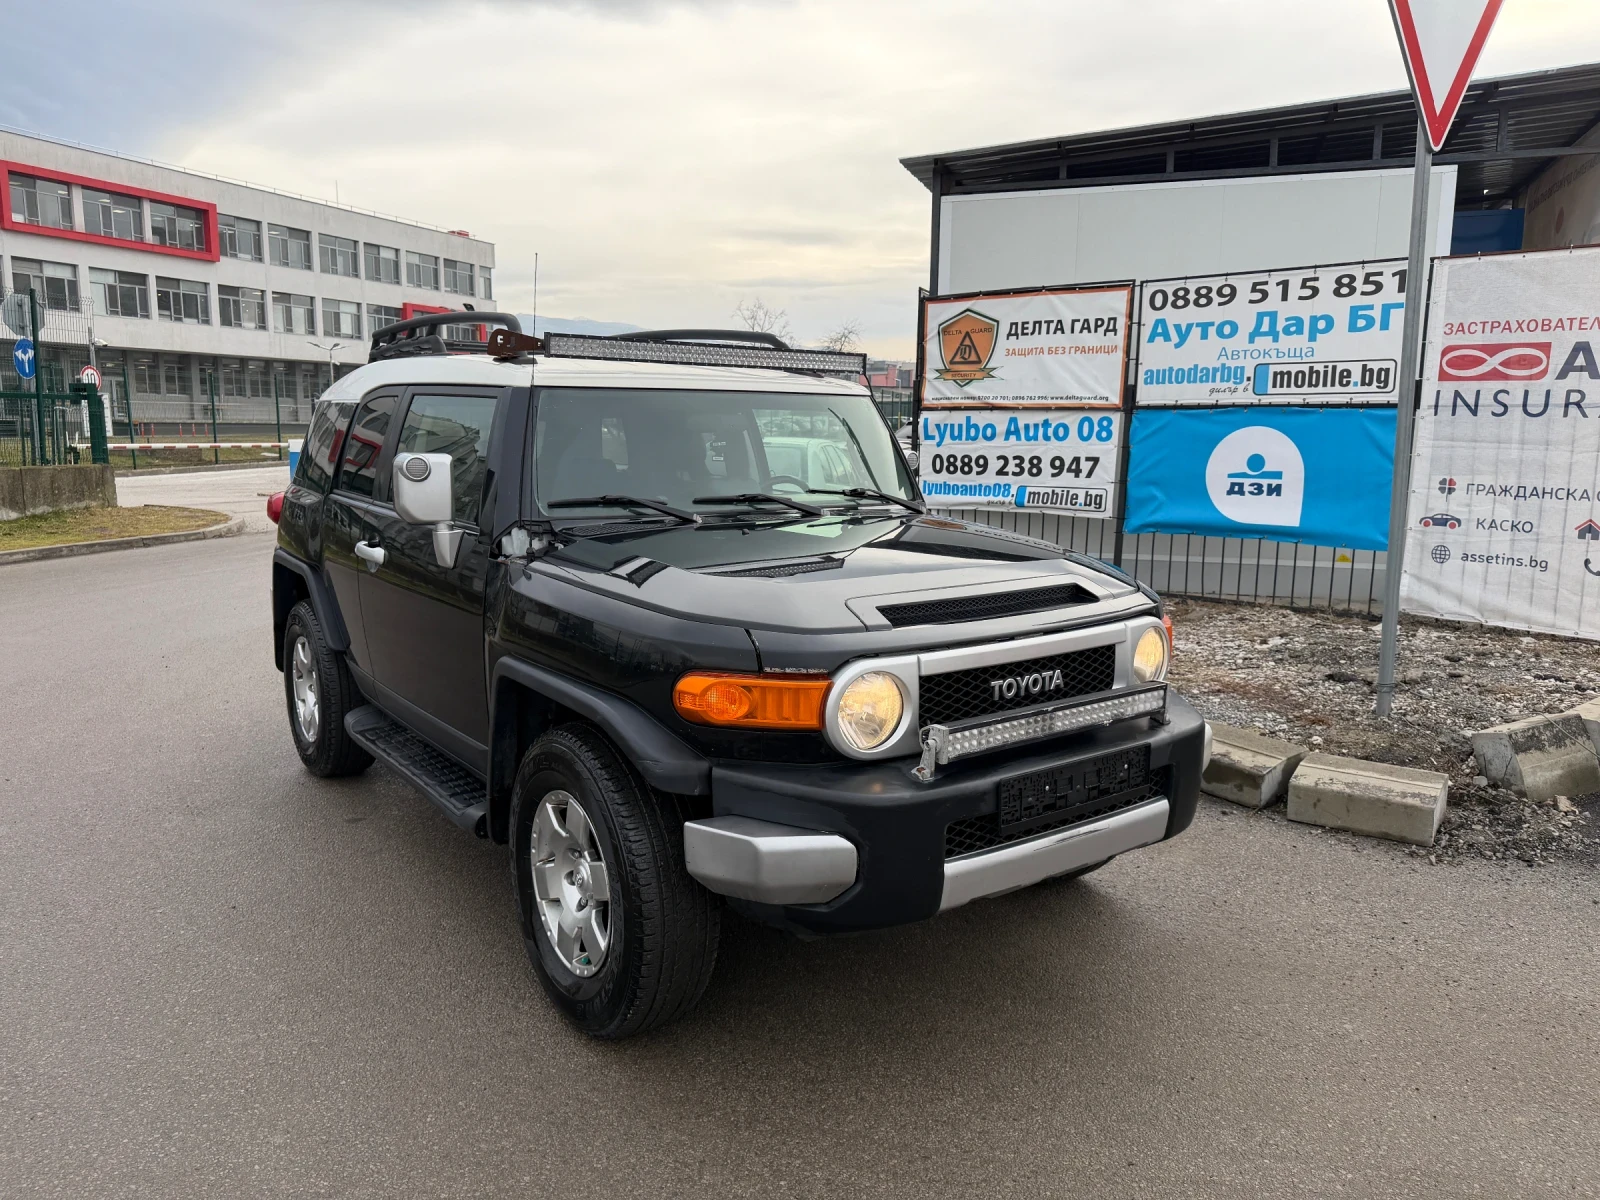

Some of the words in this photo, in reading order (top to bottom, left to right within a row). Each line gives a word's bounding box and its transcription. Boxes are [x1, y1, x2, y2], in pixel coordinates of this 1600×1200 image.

[1149, 283, 1238, 312] 0889
[1248, 276, 1320, 305] 515
[1332, 268, 1407, 298] 851
[1006, 319, 1066, 340] ДЕЛТА
[1070, 316, 1118, 337] ГАРД
[1146, 317, 1240, 349] Ауто
[1248, 310, 1335, 345] Дар
[1347, 302, 1405, 333] БГ
[1004, 346, 1045, 358] ЗАЩИТА
[1047, 345, 1067, 355] БЕЗ
[1068, 344, 1118, 356] ГРАНИЦИ
[1217, 346, 1315, 361] Автокъща
[1271, 363, 1391, 389] mobile.bg
[1050, 394, 1109, 402] www.deltaguard.org
[1433, 388, 1600, 419] INSUR
[923, 415, 997, 448] Lyubo
[1003, 416, 1070, 442] Auto
[1077, 415, 1114, 442] 08
[931, 453, 989, 476] 0889
[995, 455, 1043, 477] 238
[1050, 455, 1100, 479] 947
[1026, 489, 1104, 509] mobile.bg
[1226, 481, 1283, 497] ДЗИ
[1466, 483, 1591, 501] ГРАЖДАНСКА
[1475, 518, 1534, 533] КАСКО
[1460, 552, 1549, 572] assetins.bg
[990, 669, 1064, 701] TOYOTA
